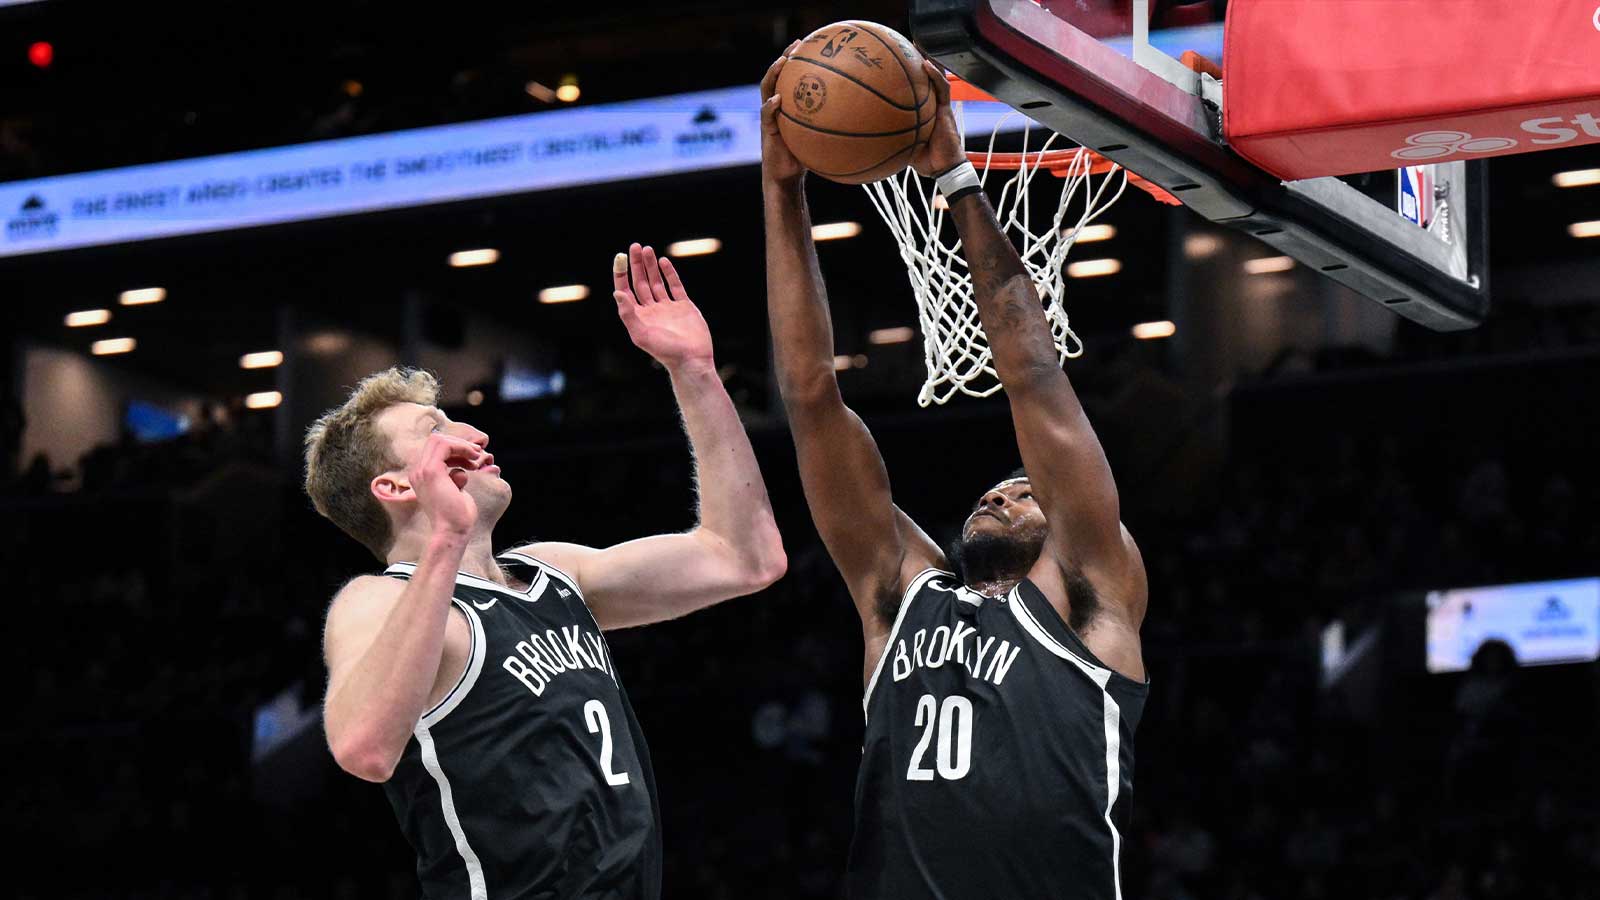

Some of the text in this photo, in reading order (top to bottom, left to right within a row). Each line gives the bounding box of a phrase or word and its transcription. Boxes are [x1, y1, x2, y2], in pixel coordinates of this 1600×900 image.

[893, 620, 1021, 686] BROKYN
[583, 699, 631, 786] 2
[906, 694, 974, 781] 20
